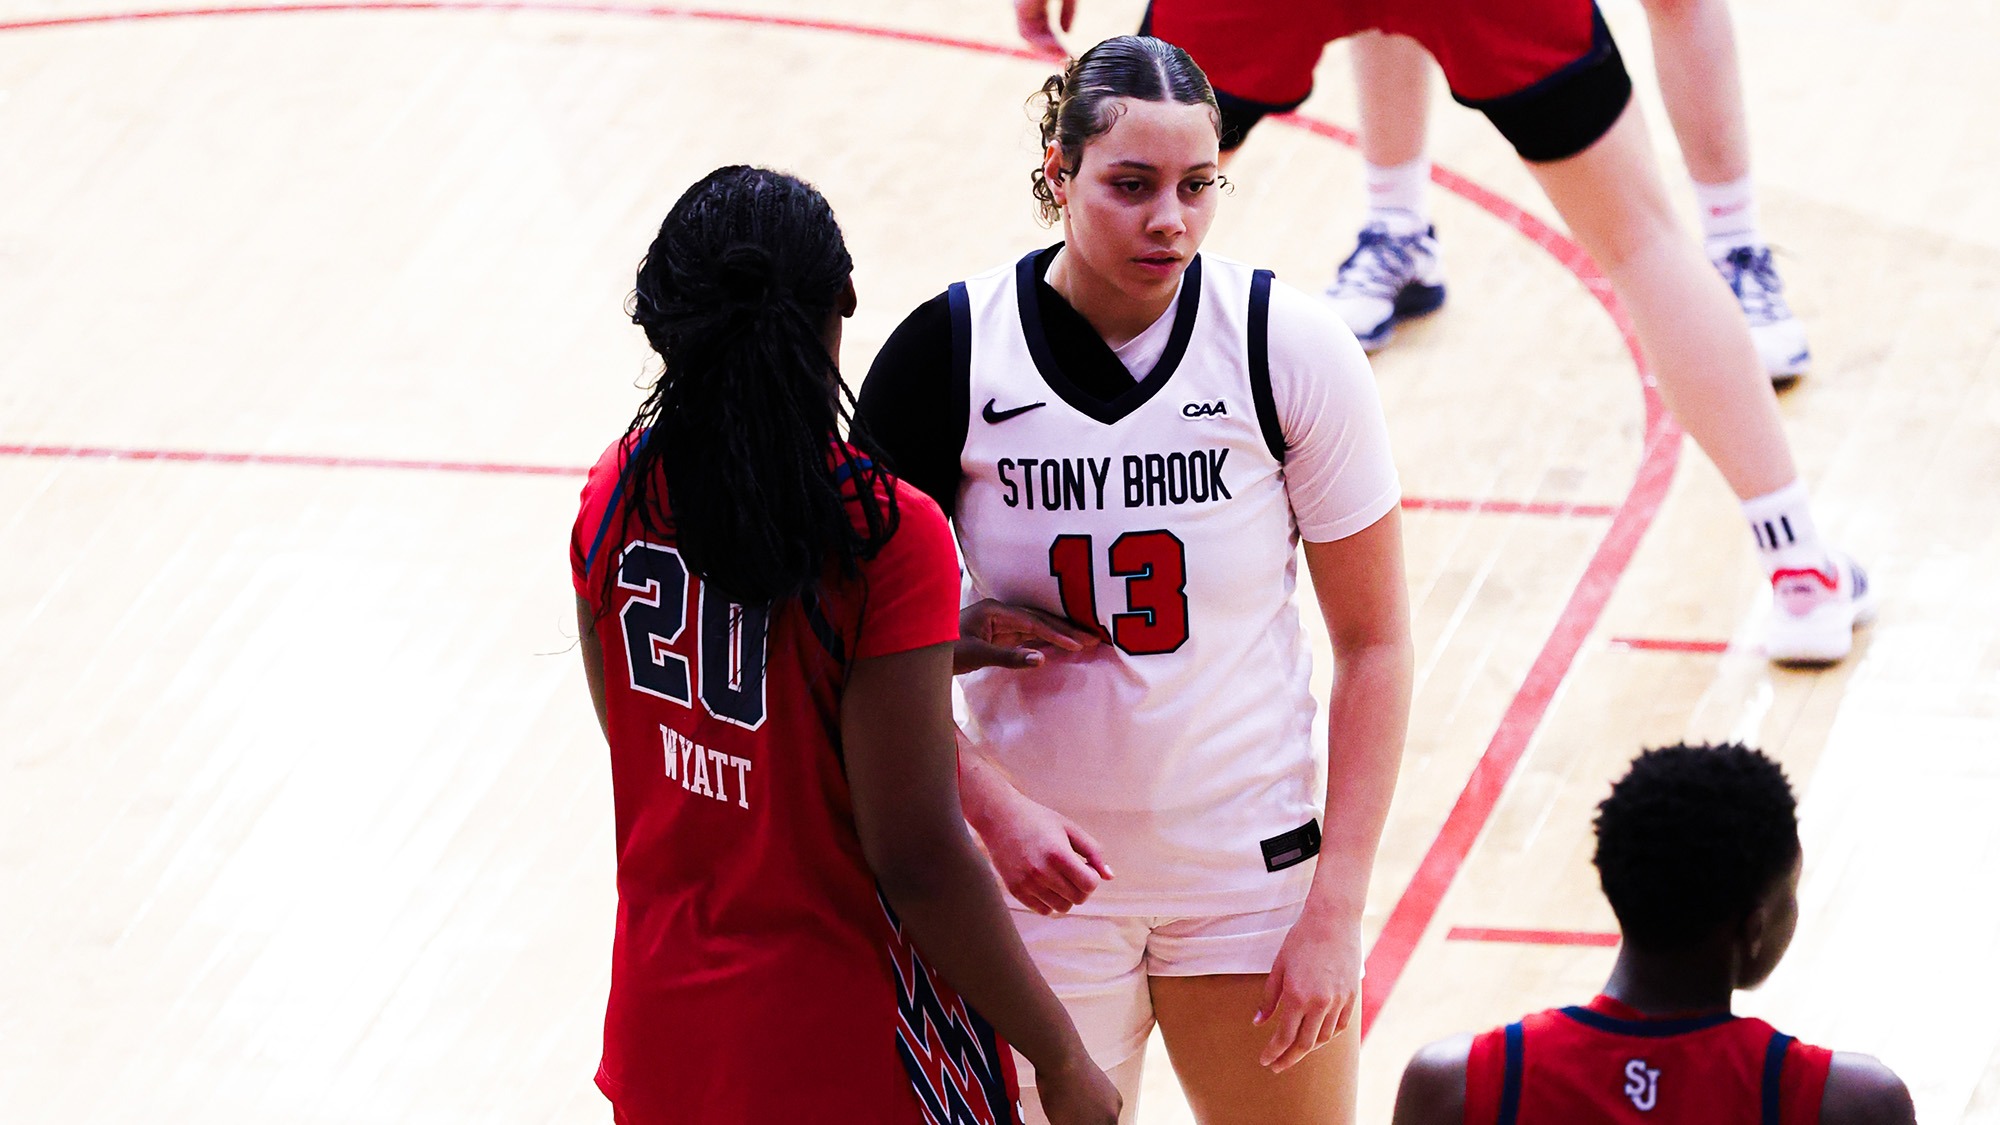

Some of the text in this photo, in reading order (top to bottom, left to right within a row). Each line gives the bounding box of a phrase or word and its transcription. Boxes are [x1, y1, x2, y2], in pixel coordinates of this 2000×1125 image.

[1183, 401, 1227, 417] CAA
[997, 448, 1232, 511] STONY BROOK
[617, 539, 771, 732] 20
[1049, 529, 1190, 656] 13
[659, 723, 751, 810] WYATT
